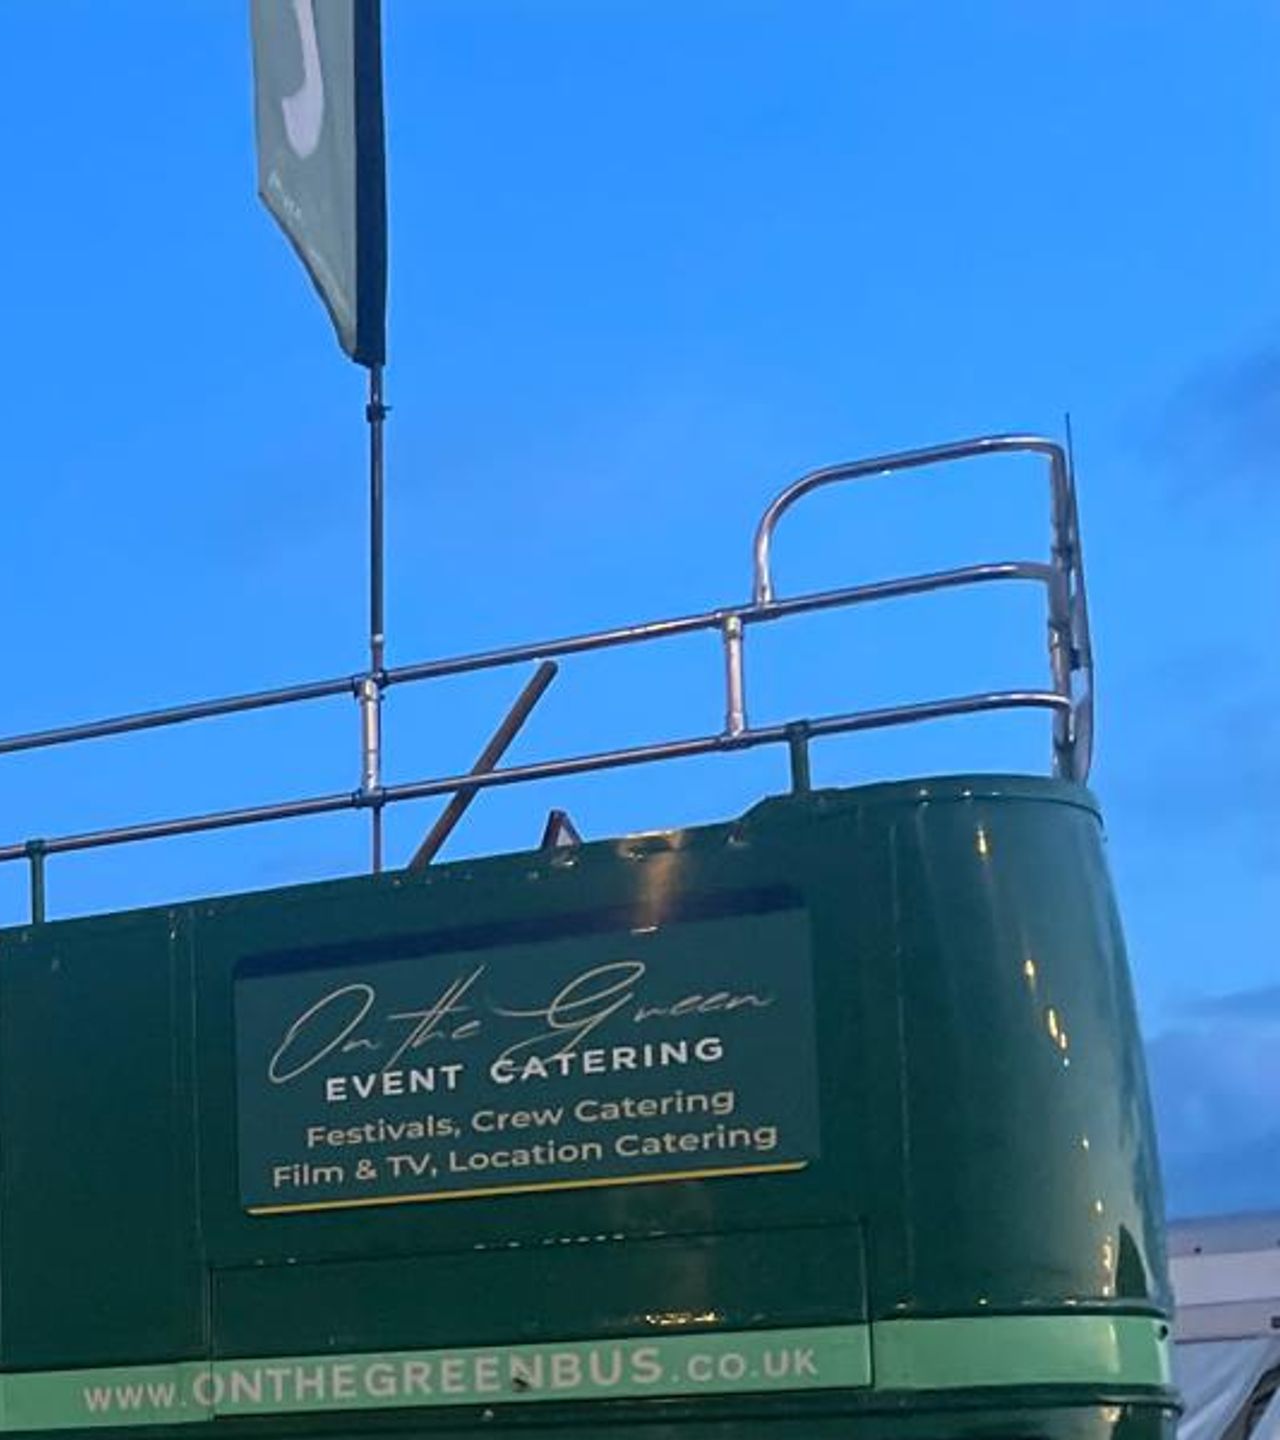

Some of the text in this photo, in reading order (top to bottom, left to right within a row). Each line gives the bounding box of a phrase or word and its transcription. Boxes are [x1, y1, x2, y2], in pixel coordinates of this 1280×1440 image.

[269, 960, 775, 1084] On the Green
[325, 1036, 725, 1101] EVENT CATERING
[306, 1089, 736, 1149] Festivals, Crew Catering
[272, 1122, 779, 1190] Film & TV, Location Catering
